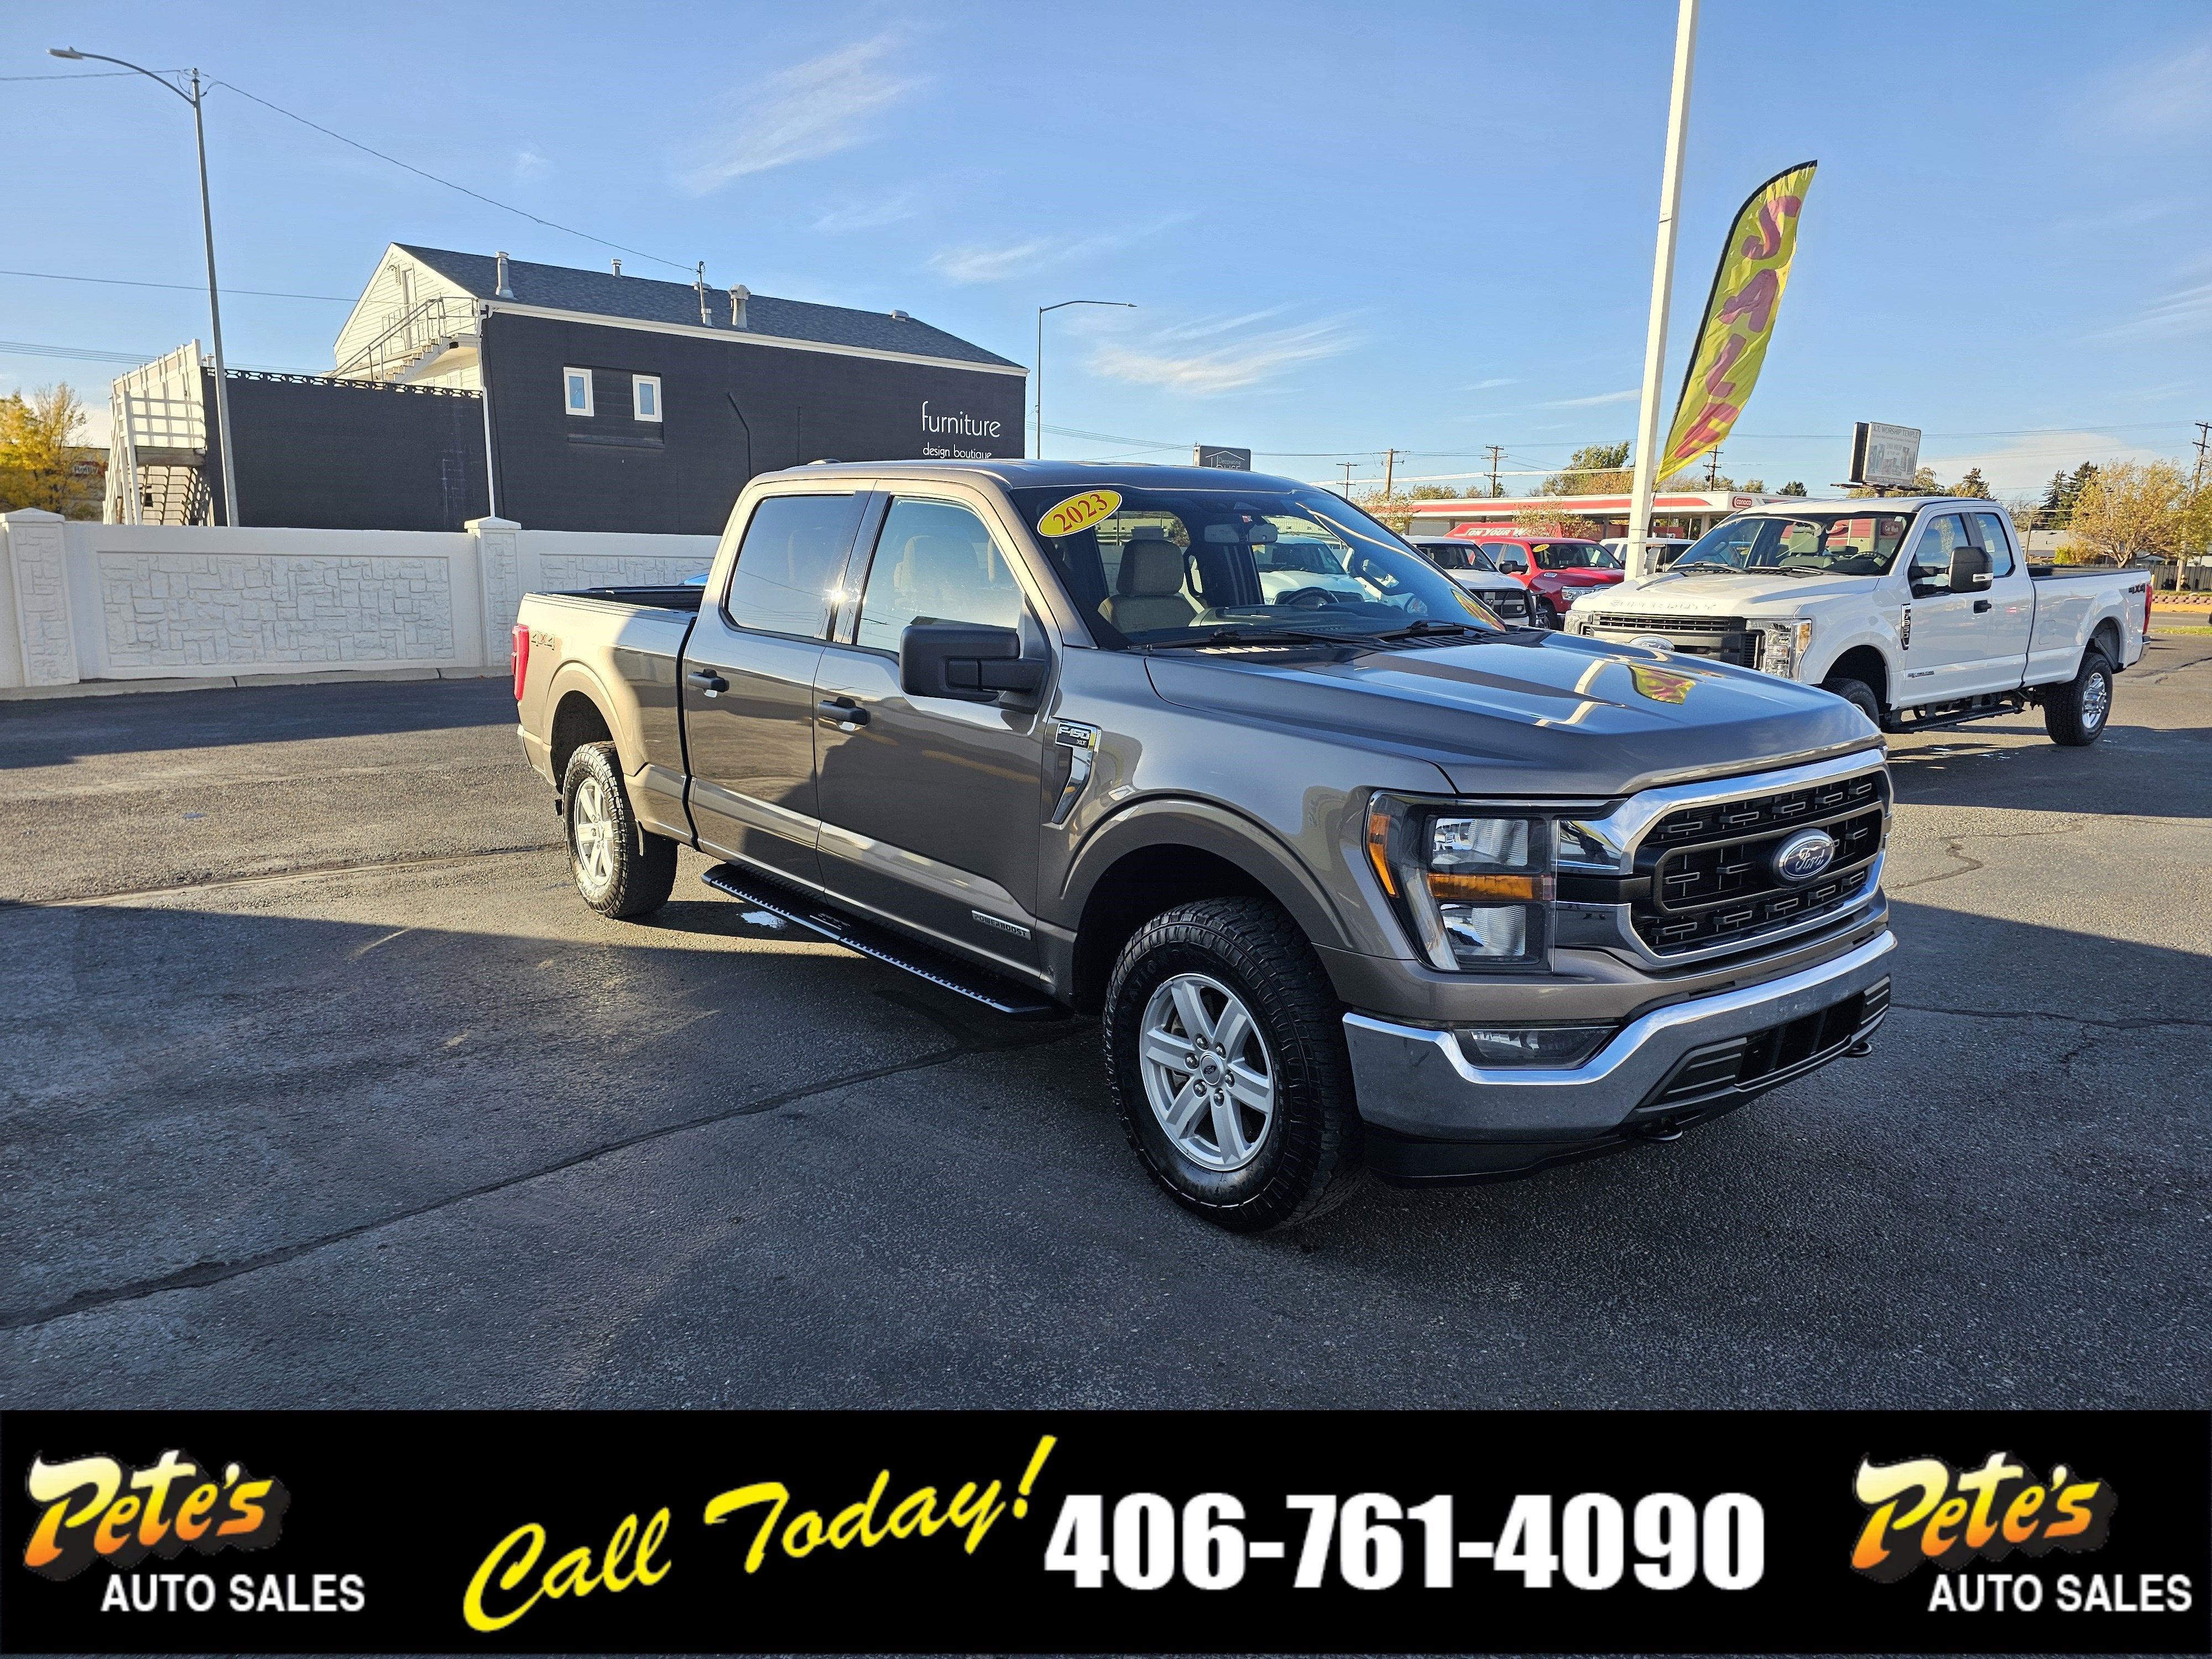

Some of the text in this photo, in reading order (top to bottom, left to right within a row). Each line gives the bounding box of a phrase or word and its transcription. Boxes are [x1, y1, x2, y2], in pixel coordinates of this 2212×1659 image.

[922, 400, 1001, 437] furniture
[1882, 426, 1902, 435] WORSHIP
[1902, 430, 1918, 439] TEMPLE
[922, 442, 992, 459] design boutique
[1053, 494, 1107, 532] 2023
[1795, 845, 1825, 873] Ford
[974, 914, 1026, 936] POWERBOOST
